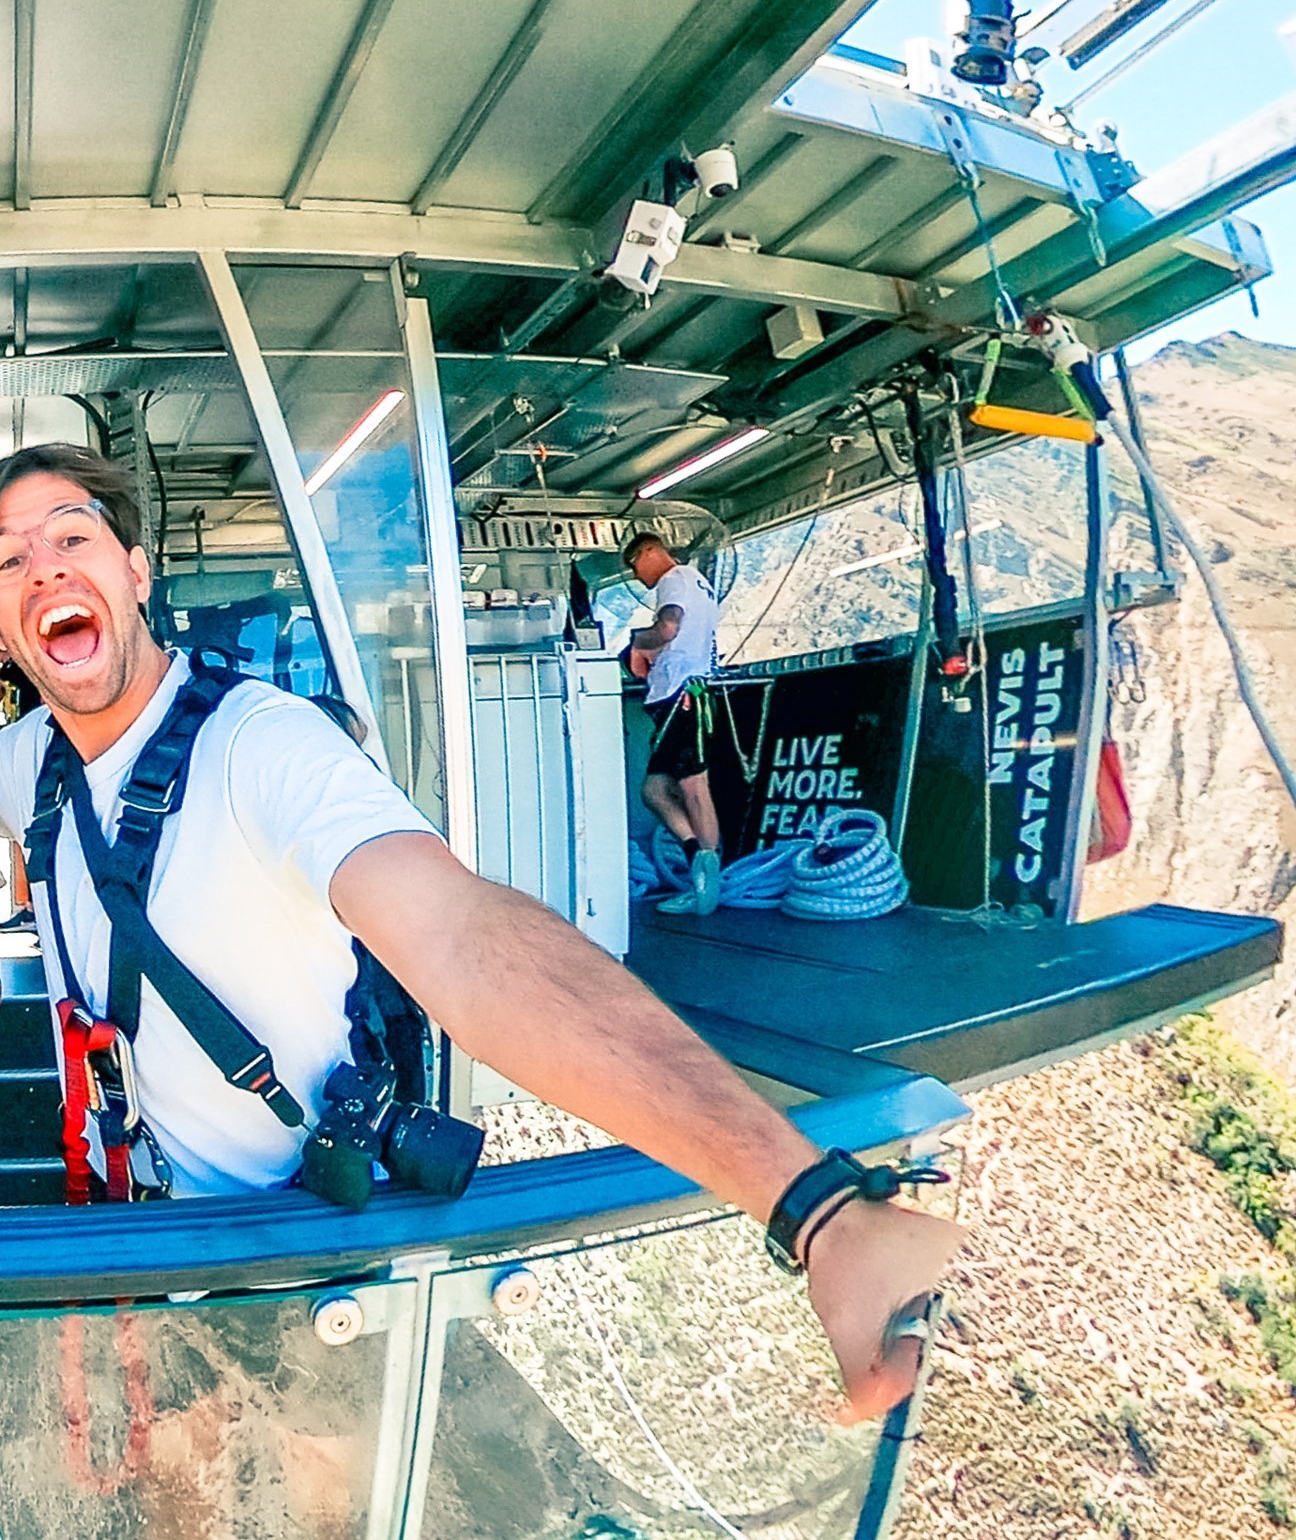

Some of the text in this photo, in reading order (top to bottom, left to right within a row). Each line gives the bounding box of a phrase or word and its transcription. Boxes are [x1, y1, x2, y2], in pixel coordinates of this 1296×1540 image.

[772, 733, 844, 766] LIVE
[988, 647, 1026, 783] NEVIS
[767, 767, 863, 799] MORE.
[1014, 641, 1065, 883] CATAPULT
